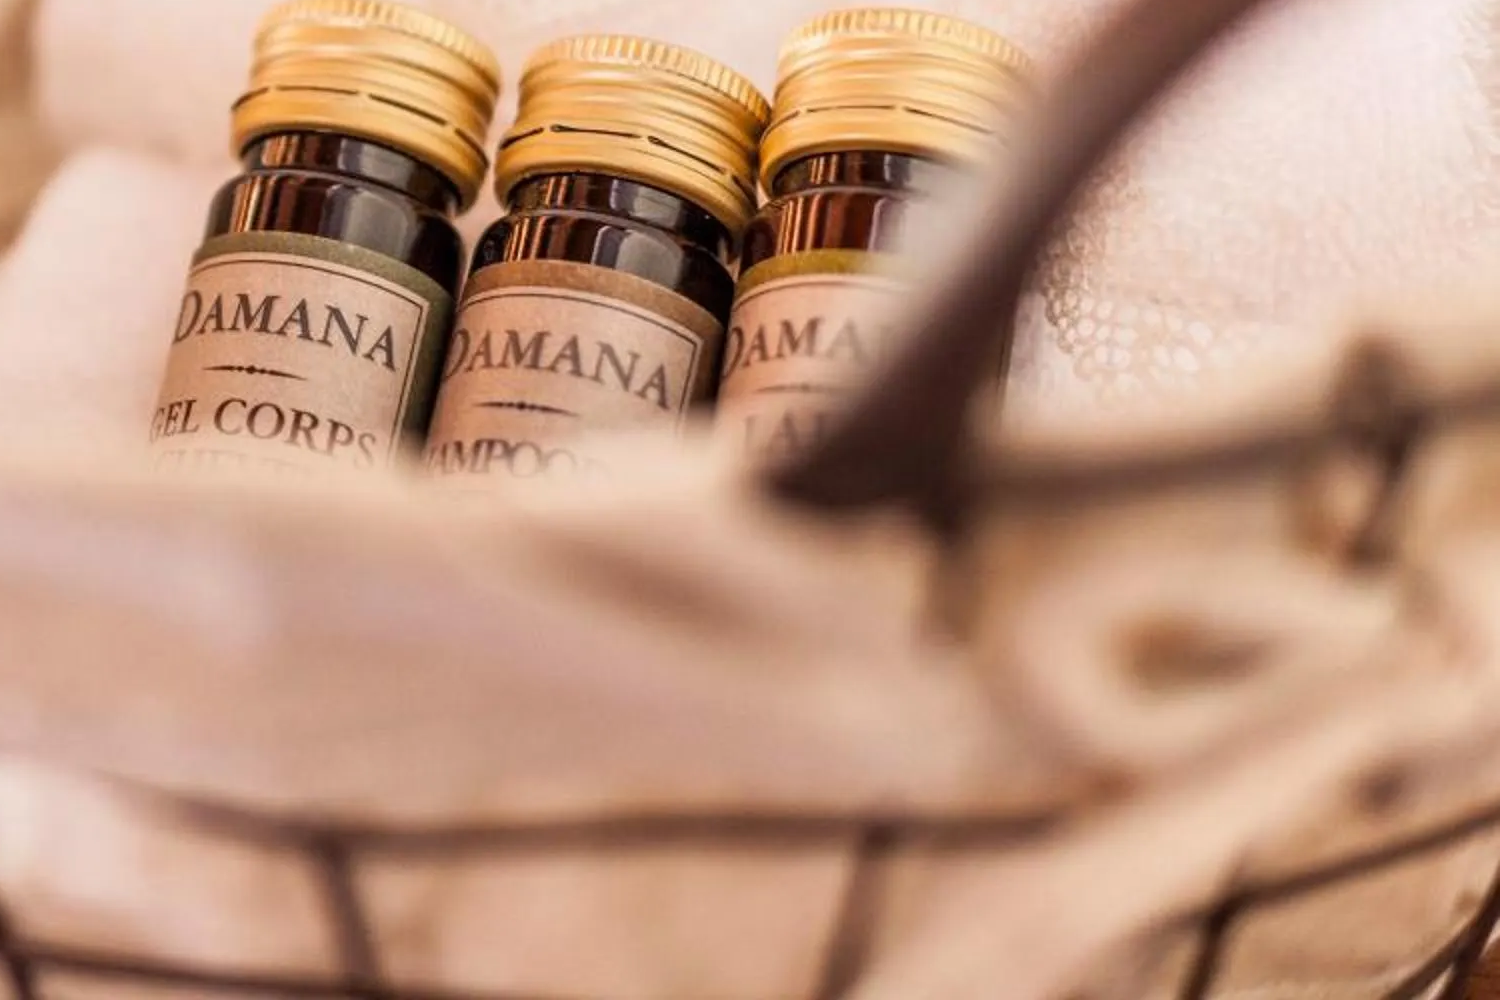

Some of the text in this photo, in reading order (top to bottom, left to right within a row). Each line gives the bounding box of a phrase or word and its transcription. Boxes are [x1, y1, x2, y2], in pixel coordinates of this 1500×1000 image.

[172, 289, 399, 372] DAMANA
[446, 327, 671, 410] DAMANA
[722, 316, 896, 378] DAMA
[213, 397, 377, 472] CORPS
